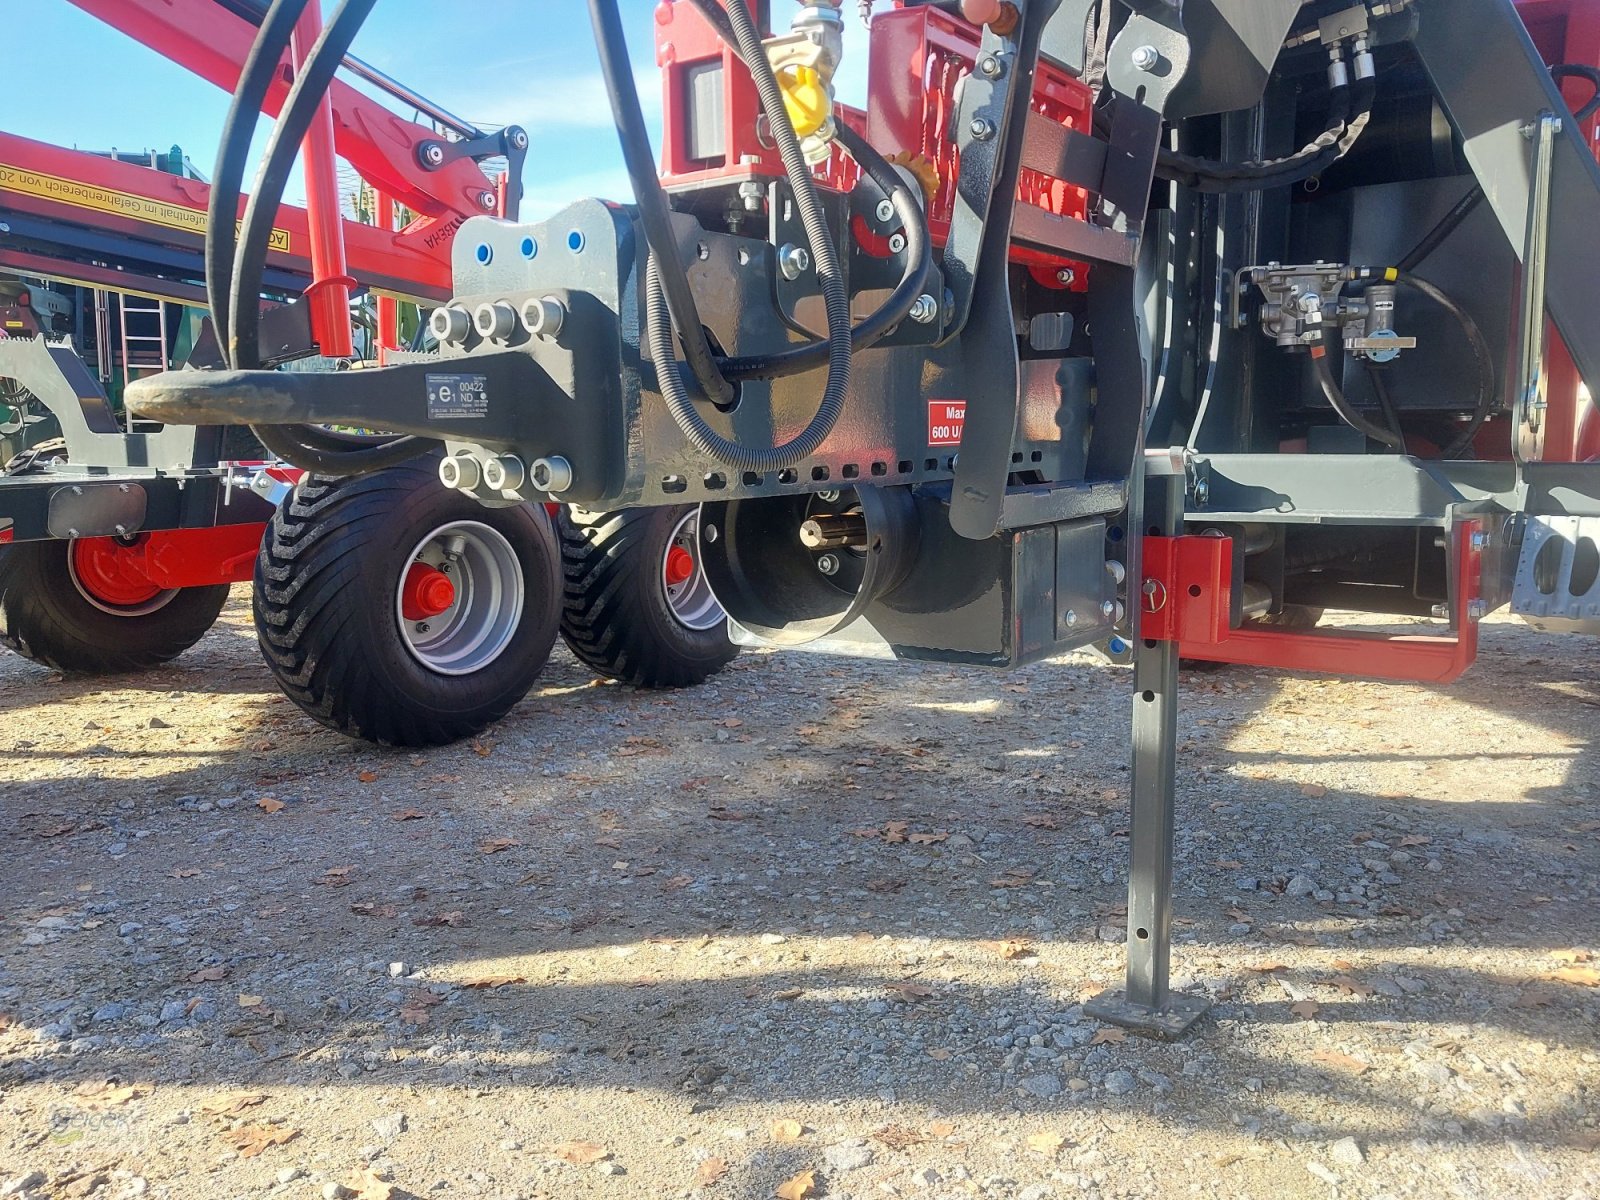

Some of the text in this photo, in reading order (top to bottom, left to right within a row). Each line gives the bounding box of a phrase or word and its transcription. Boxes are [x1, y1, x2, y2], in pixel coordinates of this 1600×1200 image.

[19, 174, 42, 188] von
[45, 180, 141, 212] Gefahrenbereich
[144, 203, 157, 216] im
[459, 382, 484, 392] 00422
[460, 393, 474, 403] ND
[932, 424, 963, 439] 600 U/
